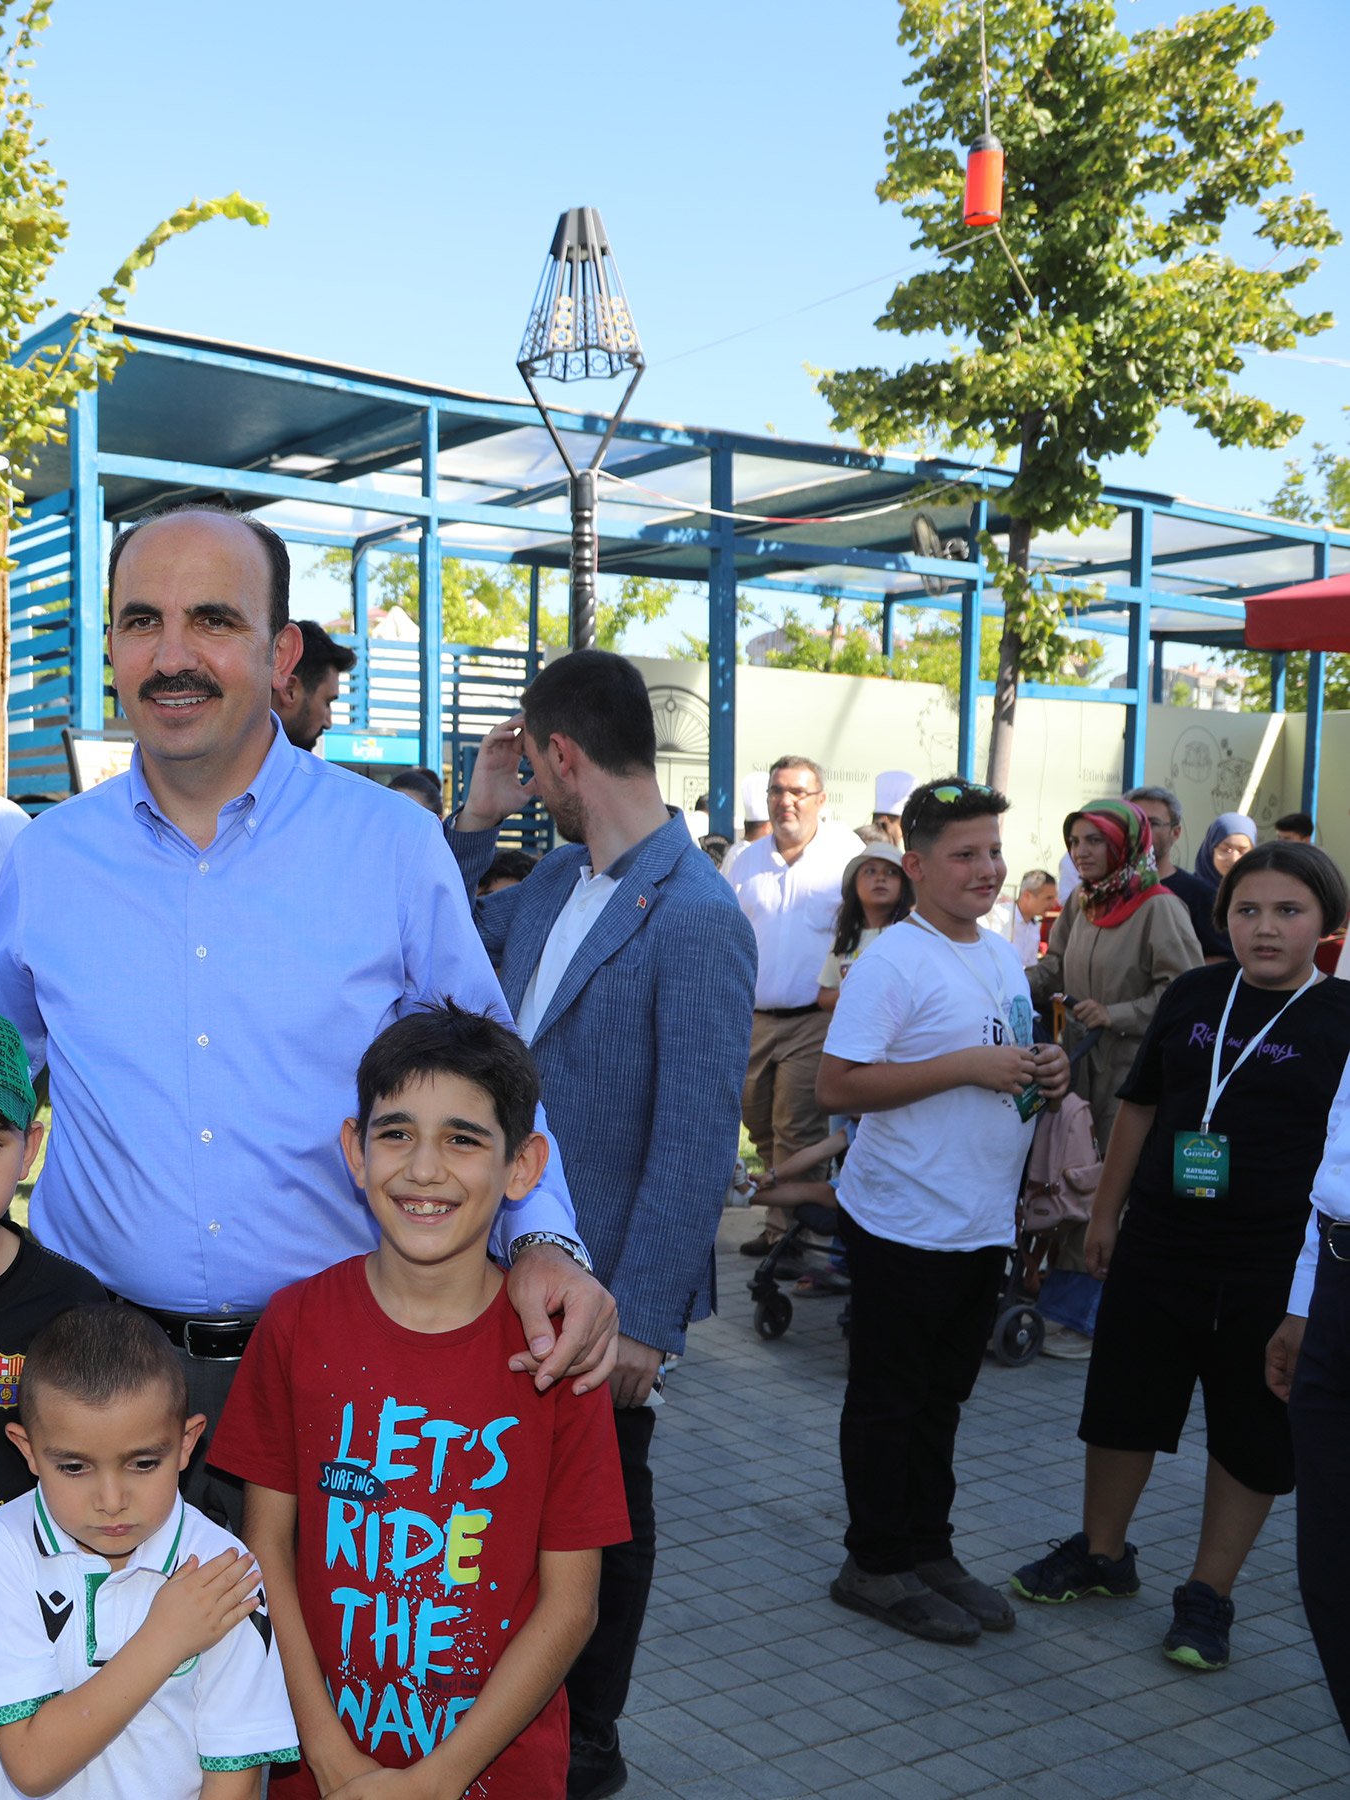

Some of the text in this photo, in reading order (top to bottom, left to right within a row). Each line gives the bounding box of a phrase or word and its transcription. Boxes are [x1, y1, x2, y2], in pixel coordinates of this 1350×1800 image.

[321, 1465, 375, 1496] SURFING
[333, 1396, 519, 1494] LET'S
[326, 1496, 494, 1597] RIDE
[331, 1587, 464, 1687] THE
